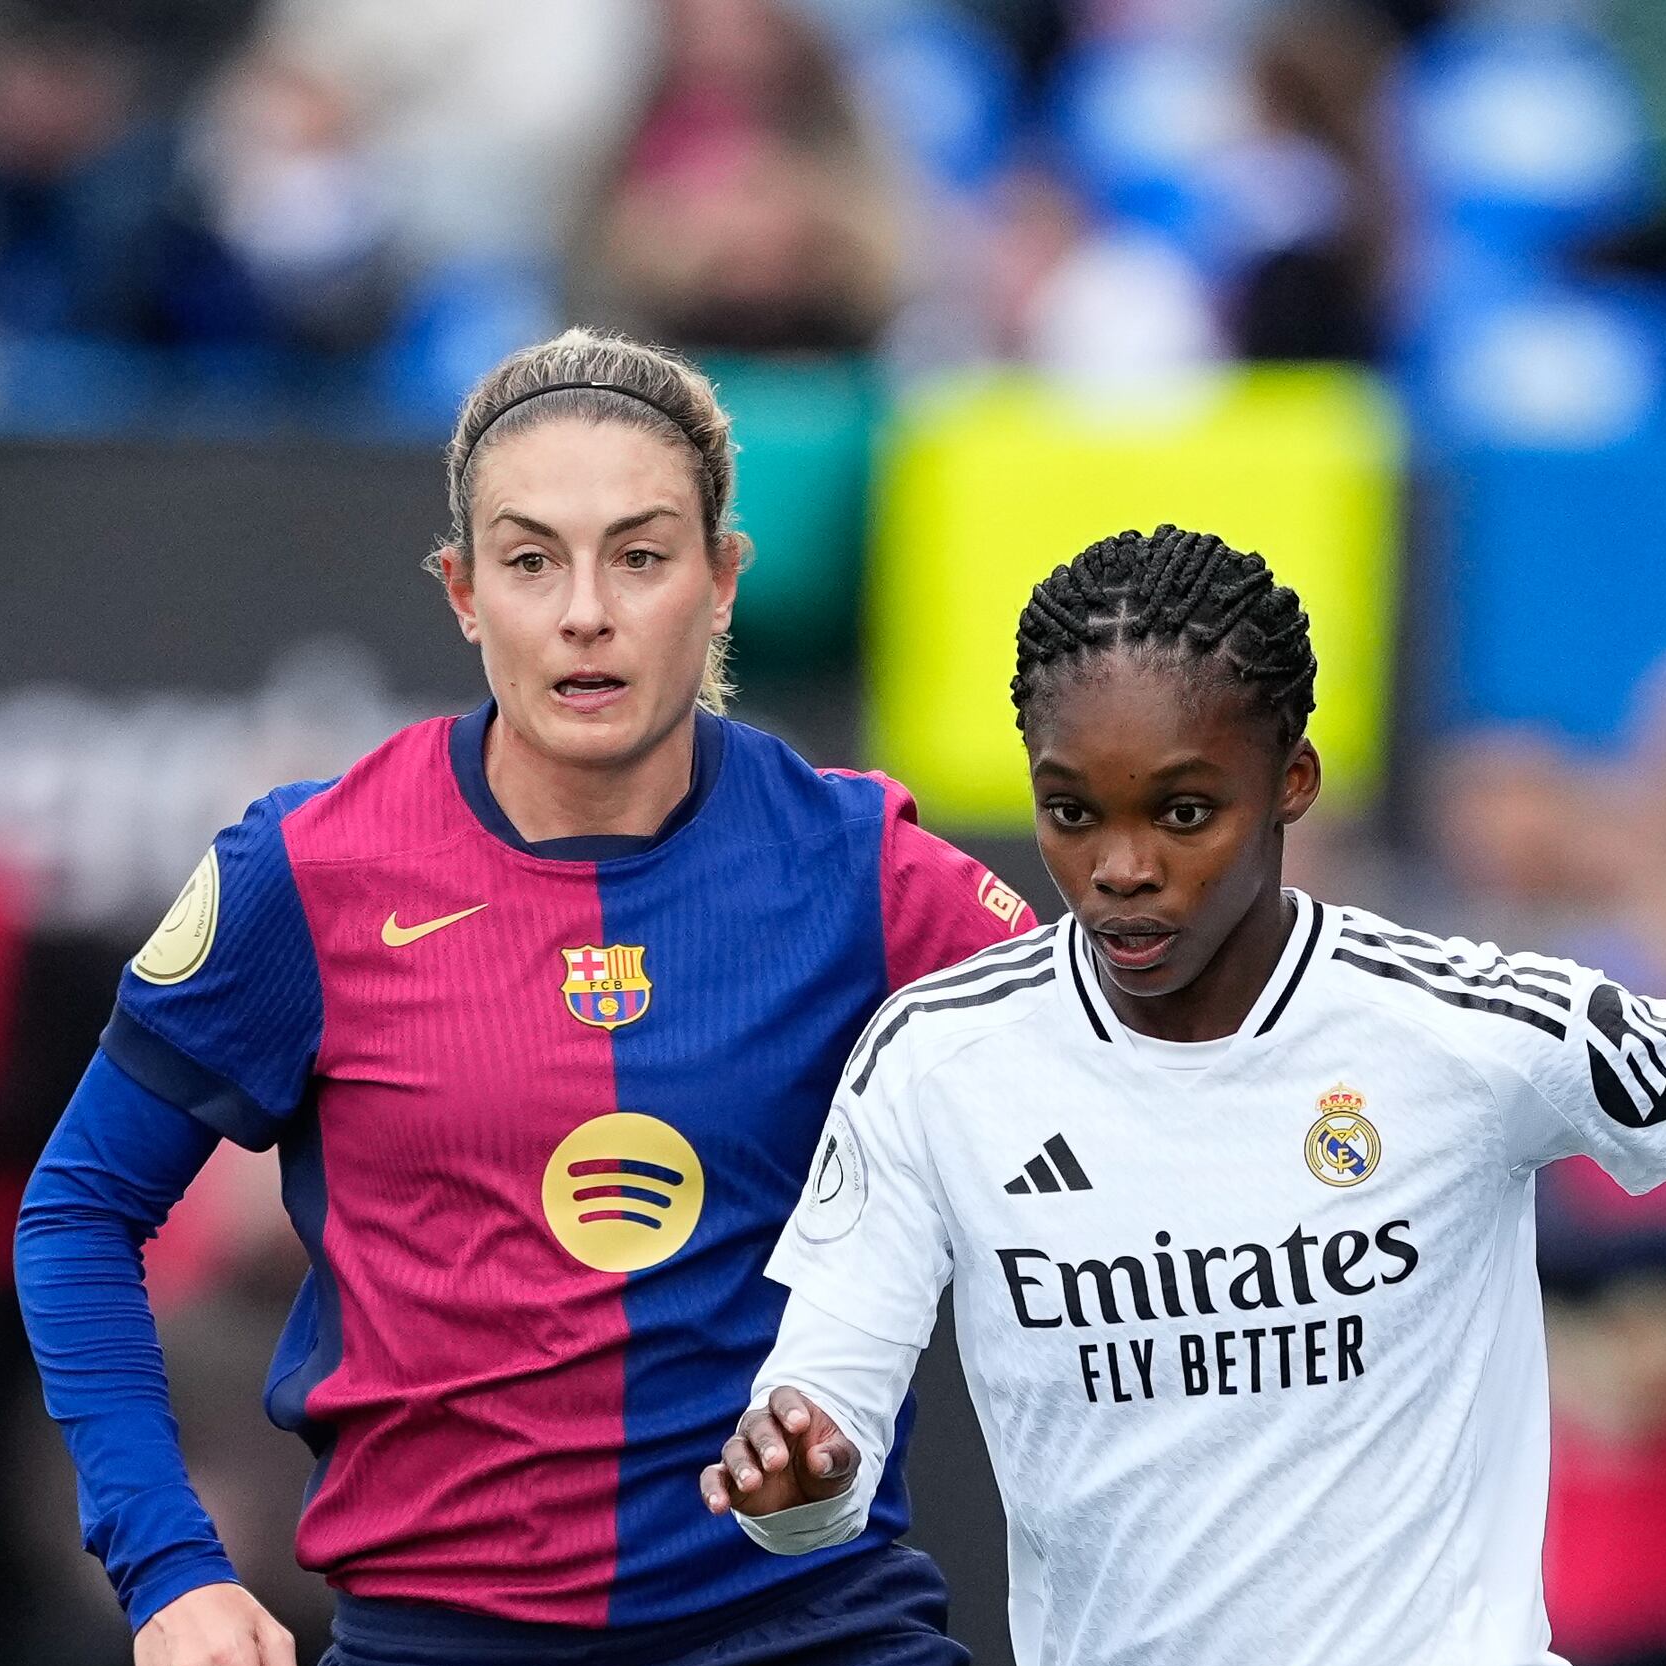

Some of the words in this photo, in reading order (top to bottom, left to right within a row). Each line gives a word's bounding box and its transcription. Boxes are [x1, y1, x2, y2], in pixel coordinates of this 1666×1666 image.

[995, 1219, 1420, 1329] Emirates
[1079, 1338, 1155, 1403] FLY
[1179, 1314, 1365, 1396] BETTER
